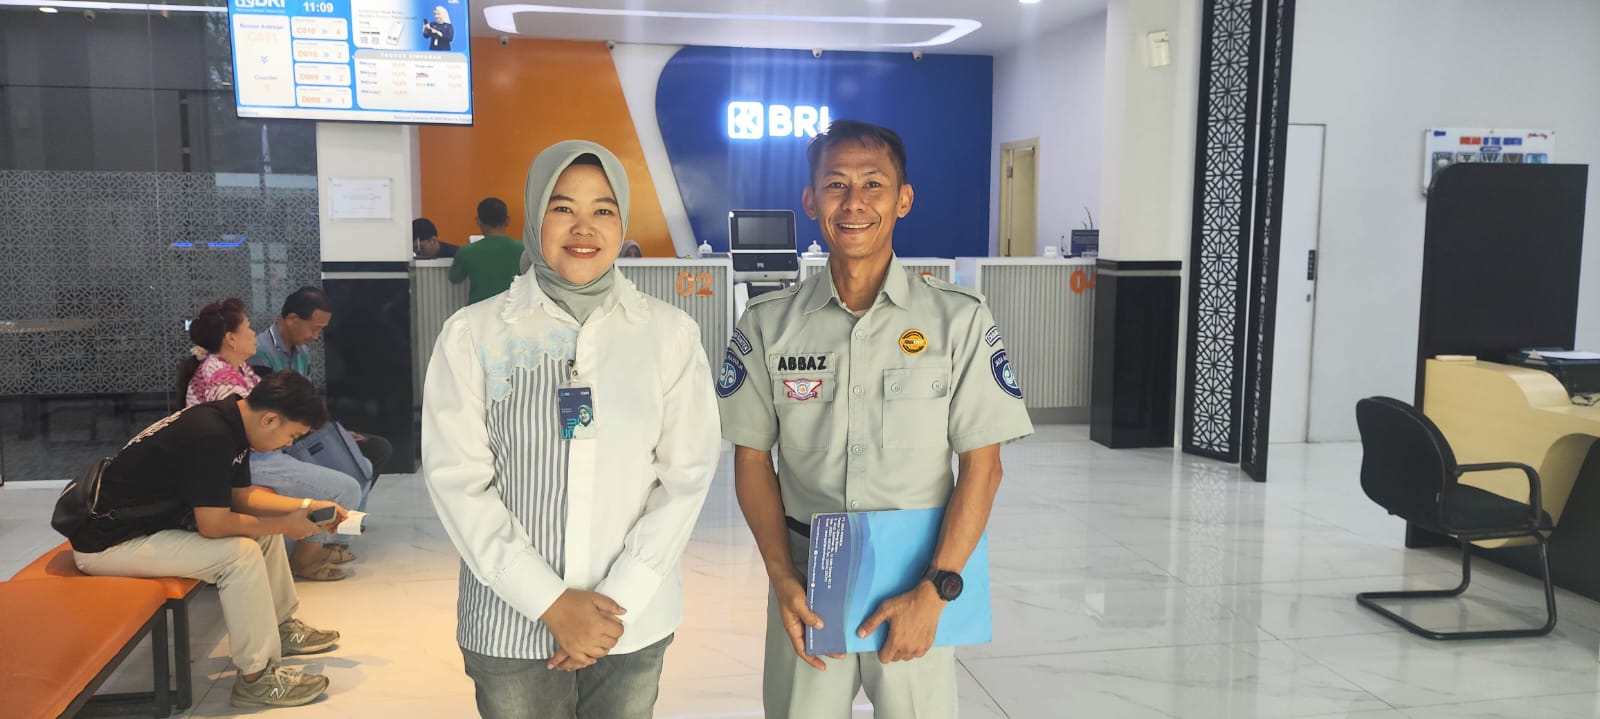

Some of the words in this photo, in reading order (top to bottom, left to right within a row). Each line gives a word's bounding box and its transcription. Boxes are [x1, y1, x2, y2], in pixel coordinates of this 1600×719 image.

[303, 2, 334, 13] 11:09
[769, 104, 830, 137] BRI
[676, 271, 713, 297] 02
[777, 355, 827, 371] ABBAZ
